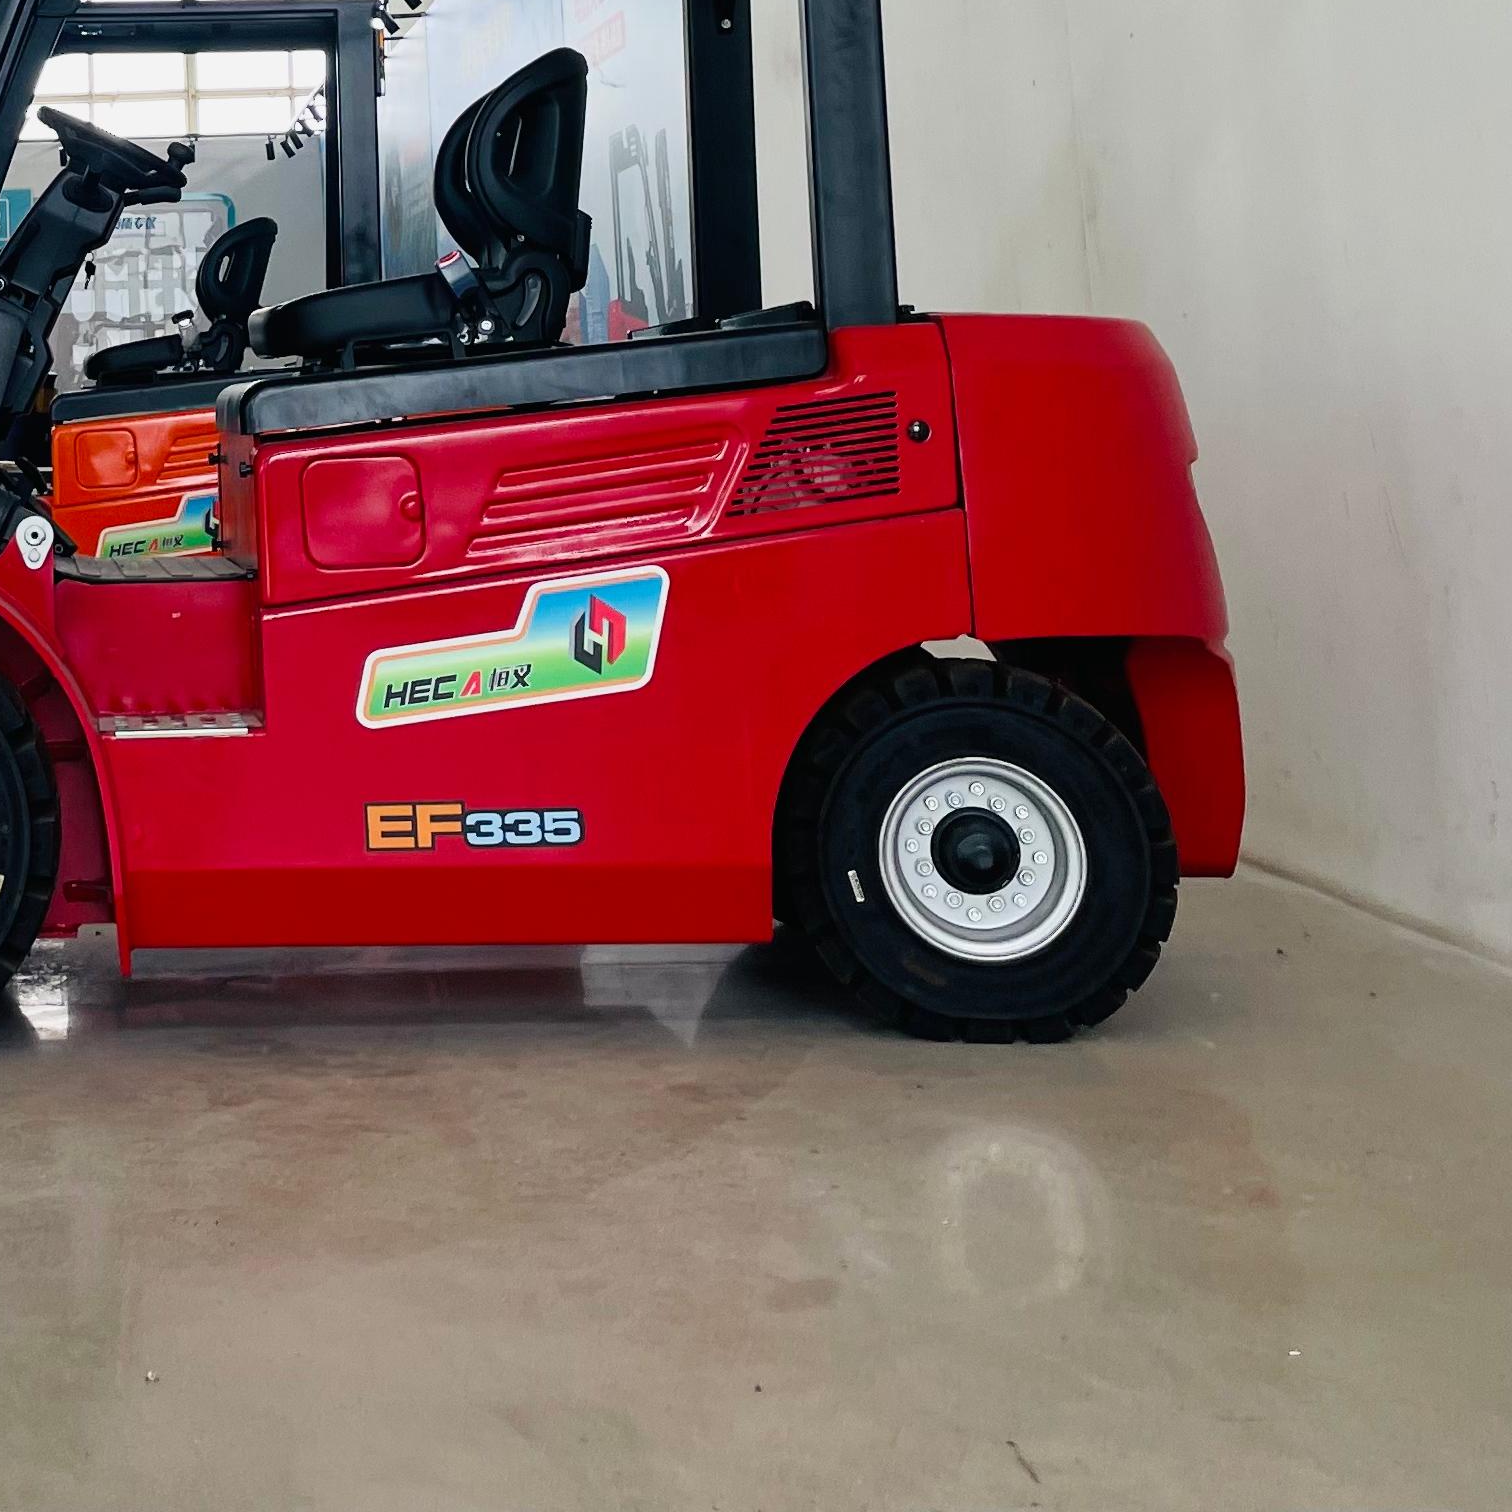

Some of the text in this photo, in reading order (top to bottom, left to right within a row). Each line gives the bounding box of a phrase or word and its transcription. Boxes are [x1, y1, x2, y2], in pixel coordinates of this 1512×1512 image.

[109, 538, 159, 558] HECA
[383, 669, 483, 709] HECA
[365, 802, 583, 849] EF335
